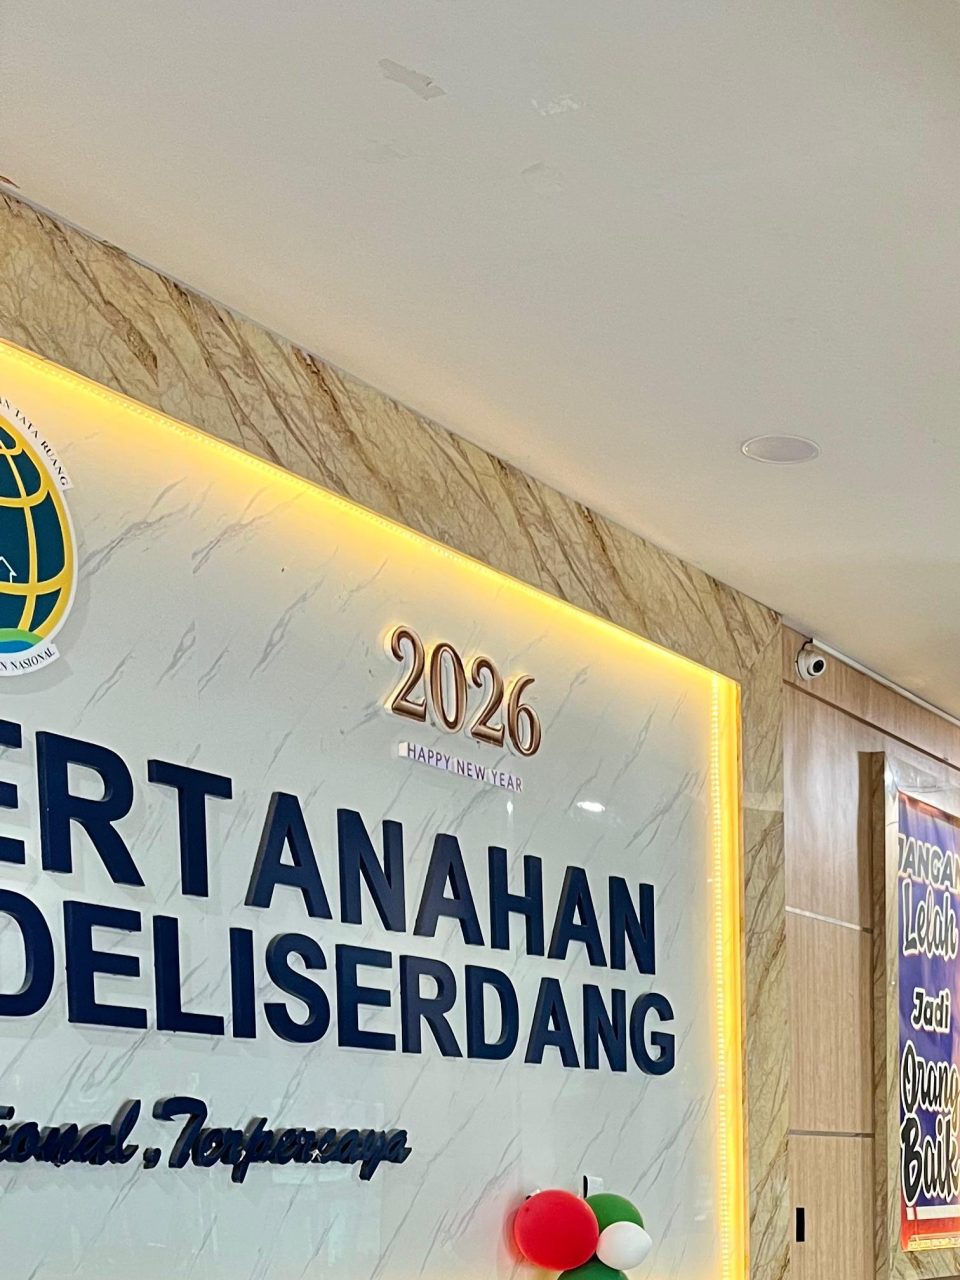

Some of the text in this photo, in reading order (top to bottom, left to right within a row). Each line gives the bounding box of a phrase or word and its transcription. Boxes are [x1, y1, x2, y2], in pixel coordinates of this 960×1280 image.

[15, 407, 38, 438] TATA
[40, 440, 68, 487] RUANG
[10, 647, 56, 671] NASIONAL
[388, 624, 542, 757] 2026
[407, 742, 522, 791] HAPPY NEW YEAR
[0, 719, 656, 975] RTANAHAN
[902, 878, 959, 961] Lelah
[911, 987, 952, 1034] Jadi
